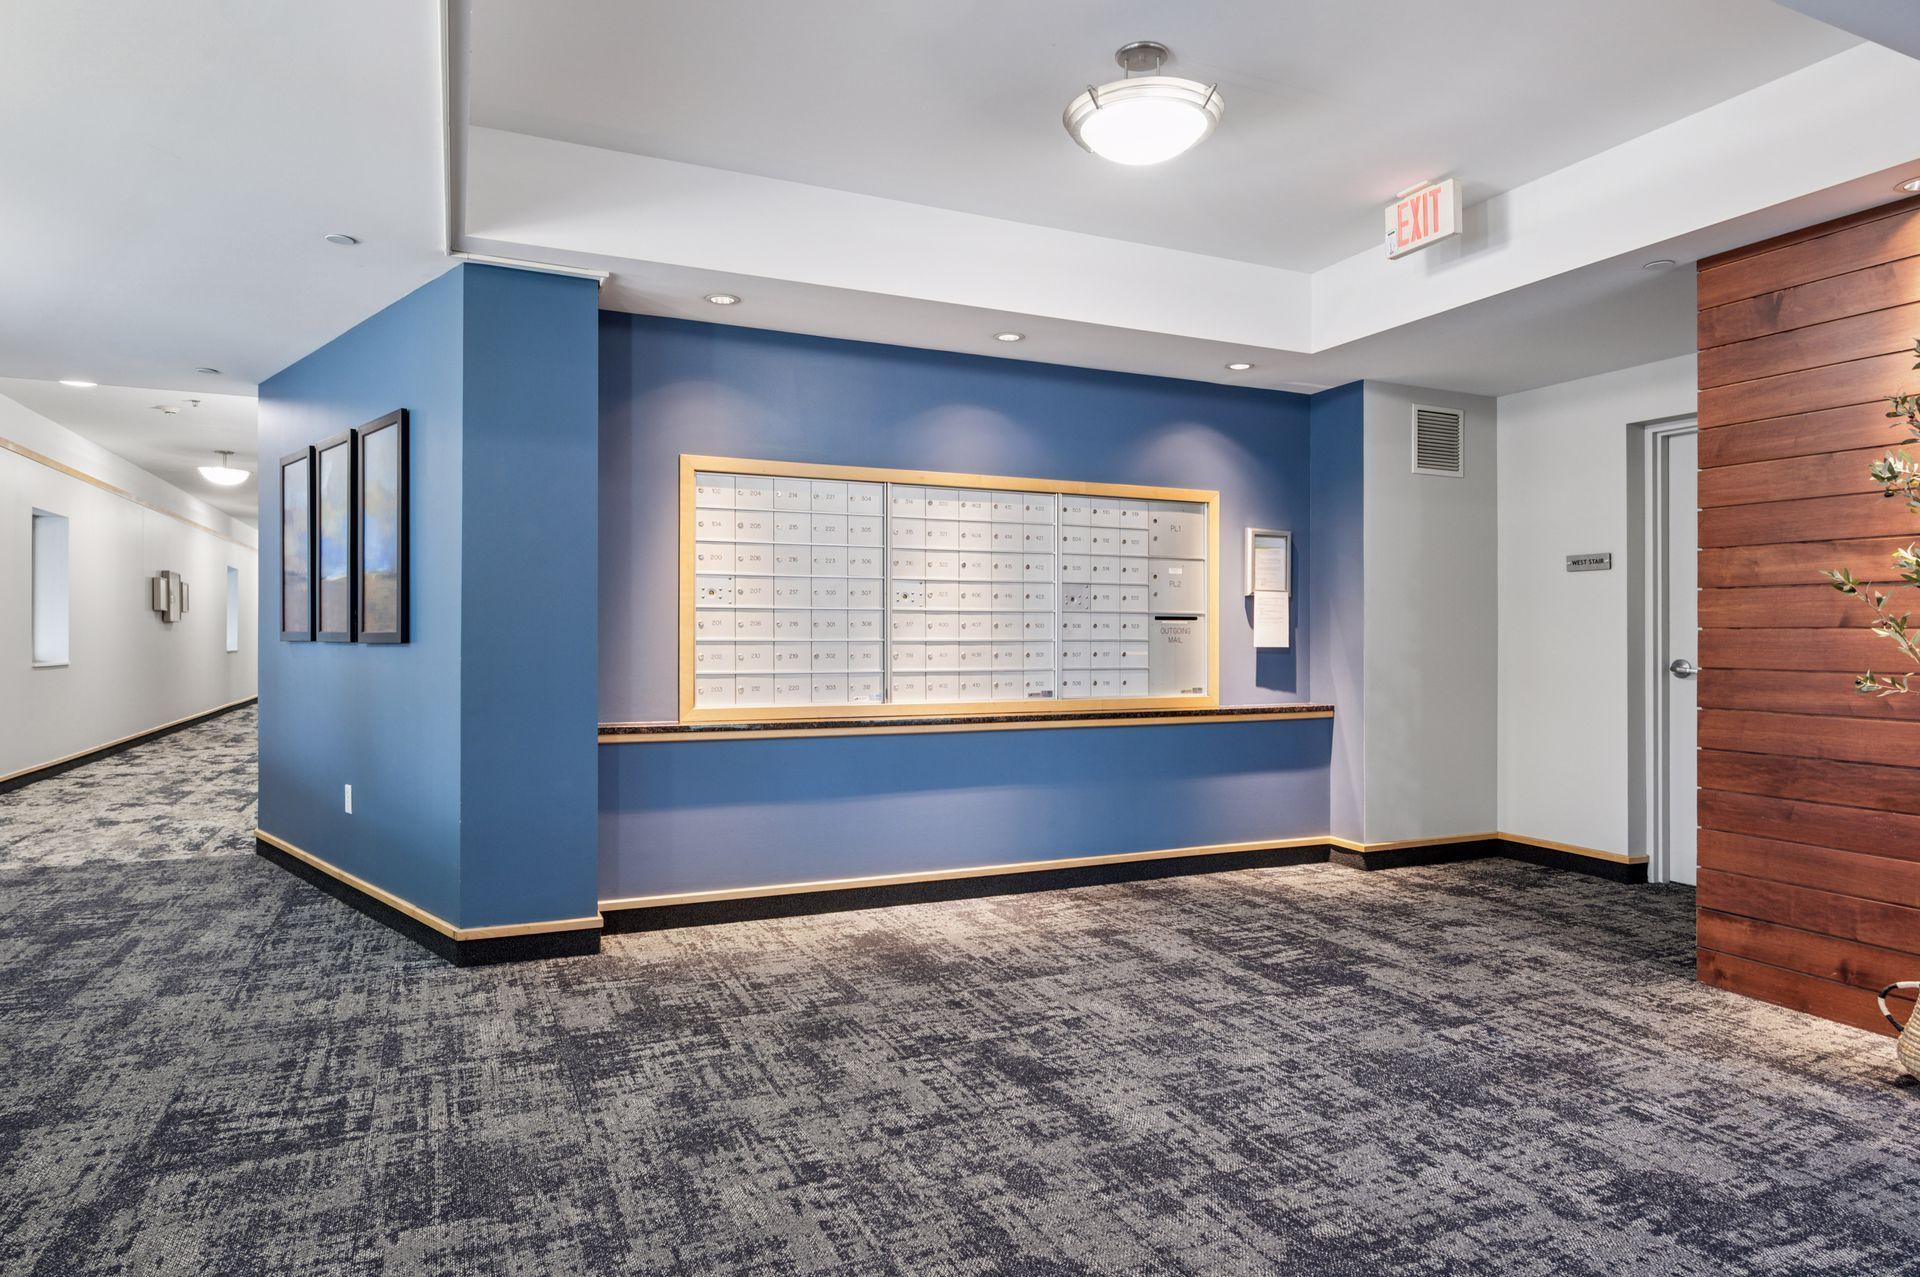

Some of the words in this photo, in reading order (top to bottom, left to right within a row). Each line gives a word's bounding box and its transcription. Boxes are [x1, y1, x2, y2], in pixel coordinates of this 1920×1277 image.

[1398, 187, 1441, 246] EXIT
[1170, 523, 1182, 532] PL1
[1161, 627, 1191, 635] OUTGOING
